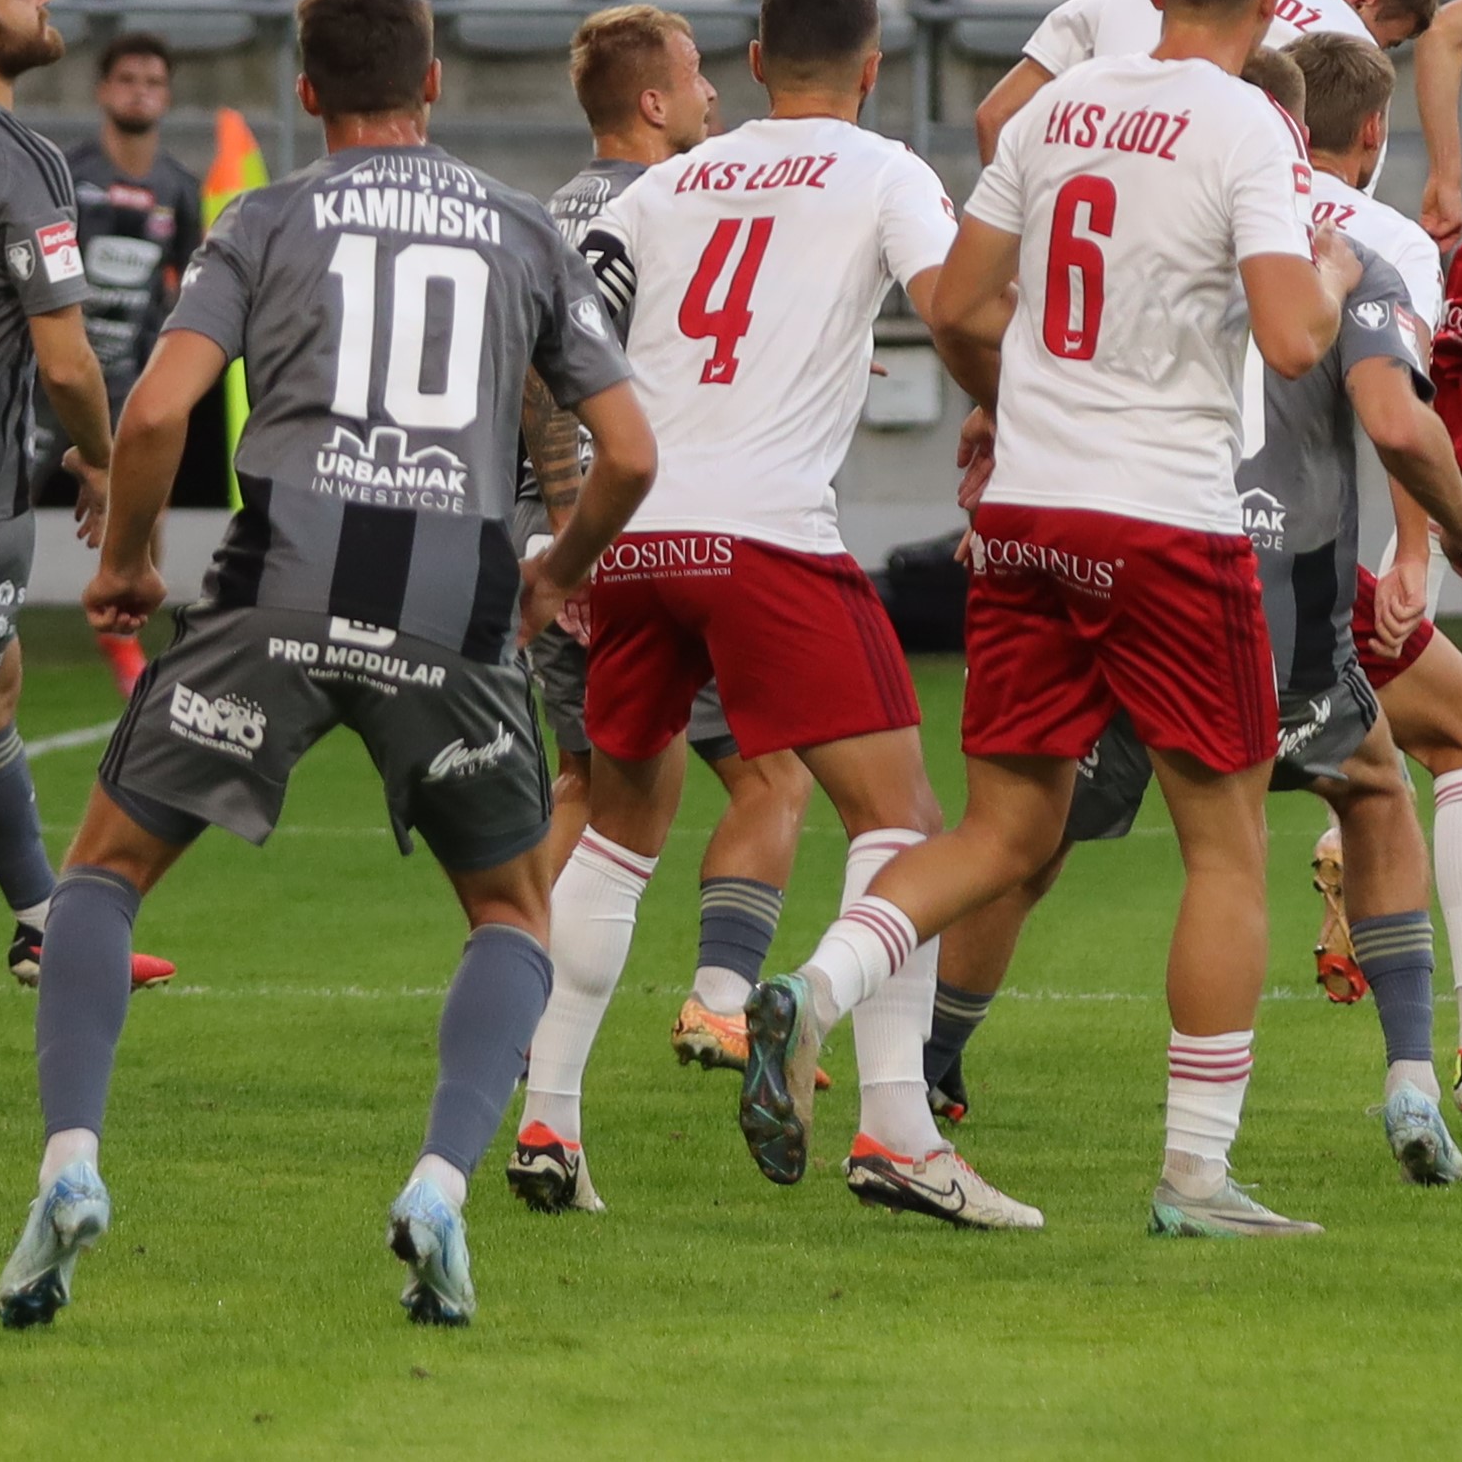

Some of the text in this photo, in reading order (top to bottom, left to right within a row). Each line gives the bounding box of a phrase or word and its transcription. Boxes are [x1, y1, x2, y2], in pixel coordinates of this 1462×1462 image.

[1044, 100, 1192, 161] ŁKS ŁÓDŹ
[674, 152, 838, 195] ŁKS ŁÓDŹ
[313, 188, 501, 246] KAMIŃSKI
[1042, 174, 1118, 360] 6
[678, 216, 775, 384] 4
[328, 232, 489, 430] 10
[311, 476, 465, 514] INWESTYCJE
[316, 450, 467, 495] URBANIAK
[599, 536, 733, 571] COSINUS
[987, 538, 1114, 587] COSINUS
[268, 637, 446, 687] PRO MODULAR
[307, 667, 340, 681] Made
[356, 674, 399, 696] change
